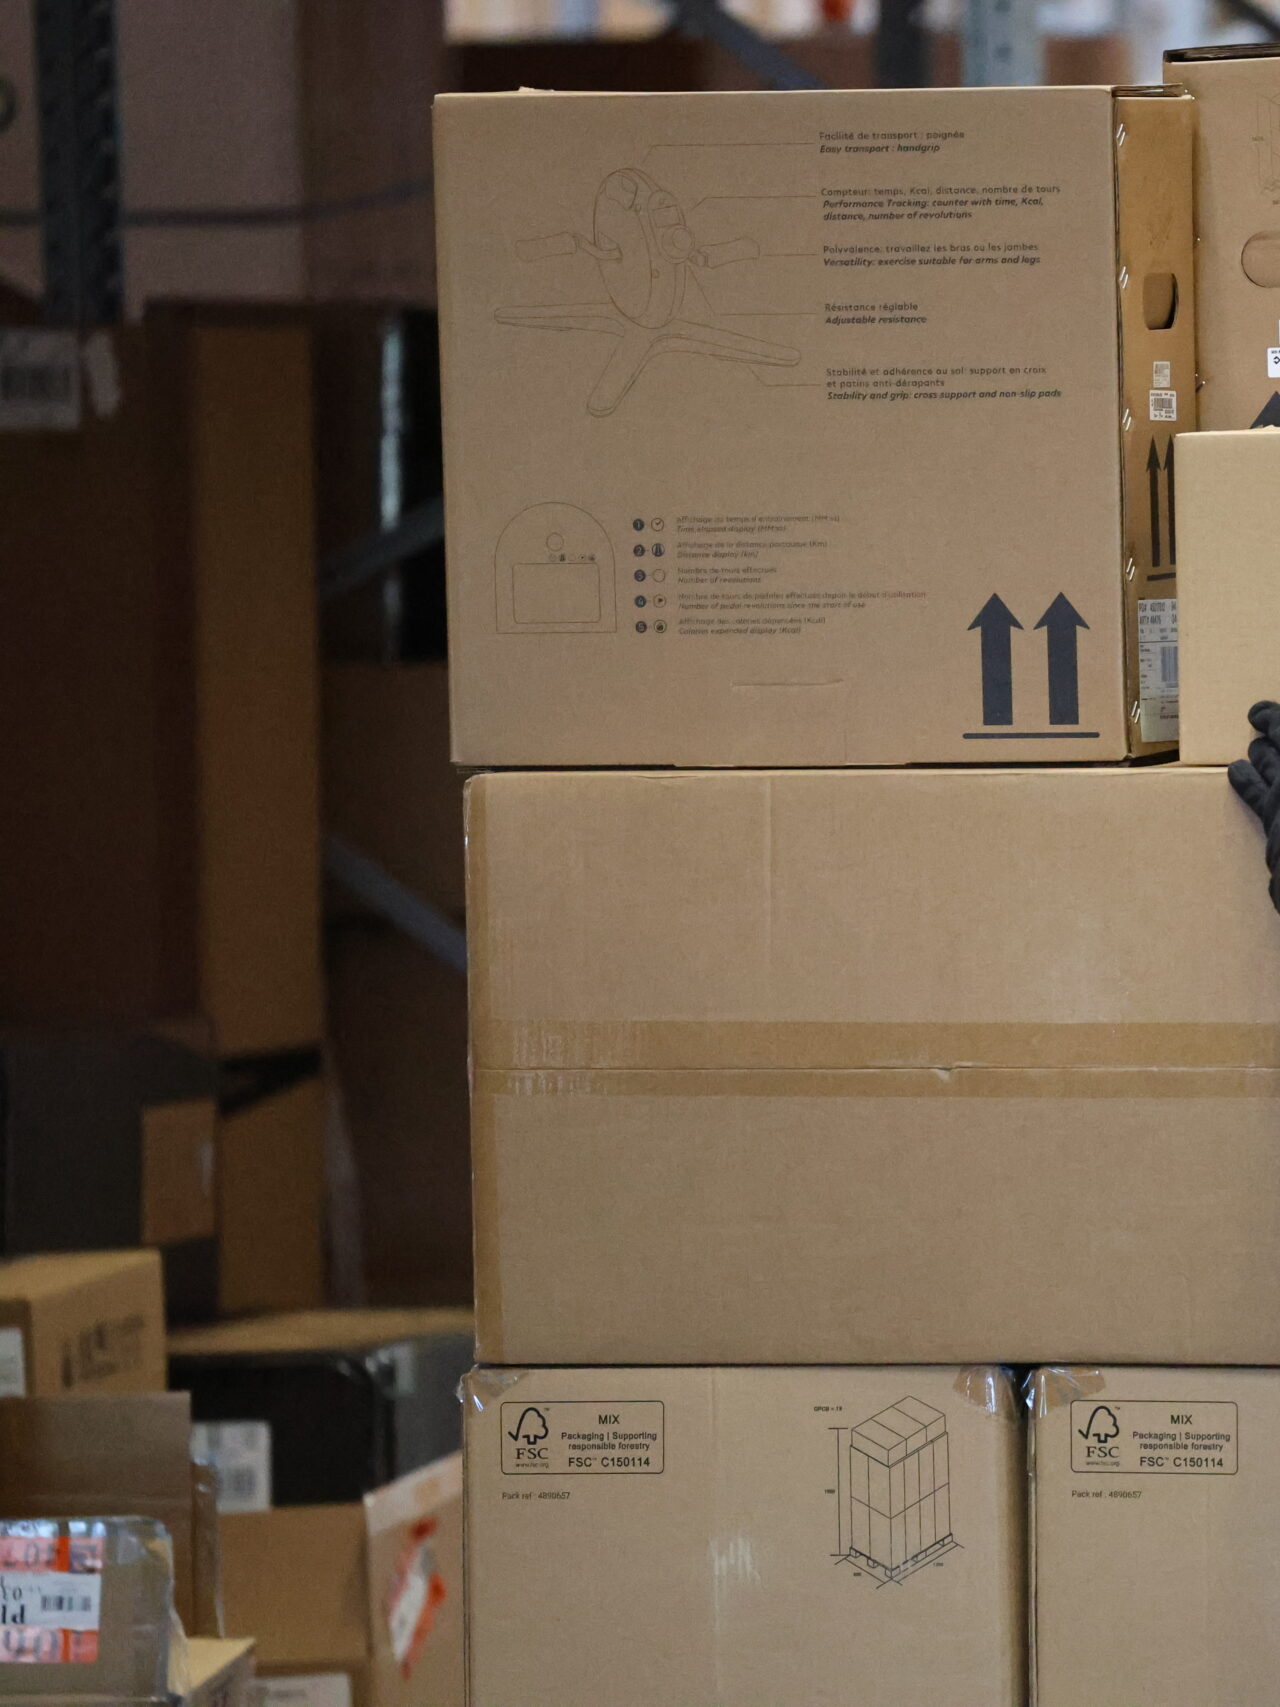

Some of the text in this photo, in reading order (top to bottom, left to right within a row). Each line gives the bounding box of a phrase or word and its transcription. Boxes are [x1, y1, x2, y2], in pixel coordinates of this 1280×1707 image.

[857, 131, 869, 140] de
[872, 131, 917, 141] transport
[820, 143, 940, 154] Easy transport handgrip
[982, 185, 1018, 194] nombre
[1021, 184, 1033, 193] de
[1036, 185, 1061, 194] tours
[823, 199, 884, 208] Performance
[932, 199, 969, 207] counter
[971, 198, 992, 207] with
[868, 212, 905, 220] number
[907, 211, 918, 220] of
[919, 211, 972, 220] revolutions
[934, 243, 947, 252] les
[950, 243, 971, 252] bras
[973, 244, 985, 252] ou
[988, 243, 1001, 252] les
[1004, 242, 1039, 253] jambes
[878, 257, 917, 265] exercise
[918, 257, 956, 265] suitable
[959, 255, 973, 264] for
[975, 256, 998, 264] arms
[1001, 255, 1020, 264] and
[1021, 255, 1041, 266] legs
[824, 303, 876, 312] Résistance
[825, 314, 927, 325] Adjustable resistance
[826, 367, 866, 376] Stabilité
[869, 368, 879, 376] et
[883, 367, 933, 376] adhérence
[970, 367, 1006, 377] support
[1023, 366, 1047, 374] croix
[826, 380, 836, 388] et
[827, 391, 867, 401] Stability
[869, 391, 888, 400] and
[940, 390, 976, 400] support
[978, 390, 997, 399] and
[1038, 388, 1062, 400] pads
[598, 1414, 620, 1425] MIX
[1170, 1414, 1193, 1425] MIX
[561, 1431, 657, 1442] Packaging Supporting
[1132, 1431, 1231, 1442] Packaging Supporting
[568, 1442, 650, 1452] responsible forestry
[1086, 1446, 1120, 1458] FSC
[1139, 1441, 1224, 1452] responsible forestry
[516, 1447, 549, 1460] FSC
[601, 1456, 651, 1468] C150114
[1173, 1456, 1224, 1468] C150114
[501, 1491, 520, 1500] Pack
[1071, 1490, 1091, 1499] Pack
[1092, 1490, 1103, 1499] ref
